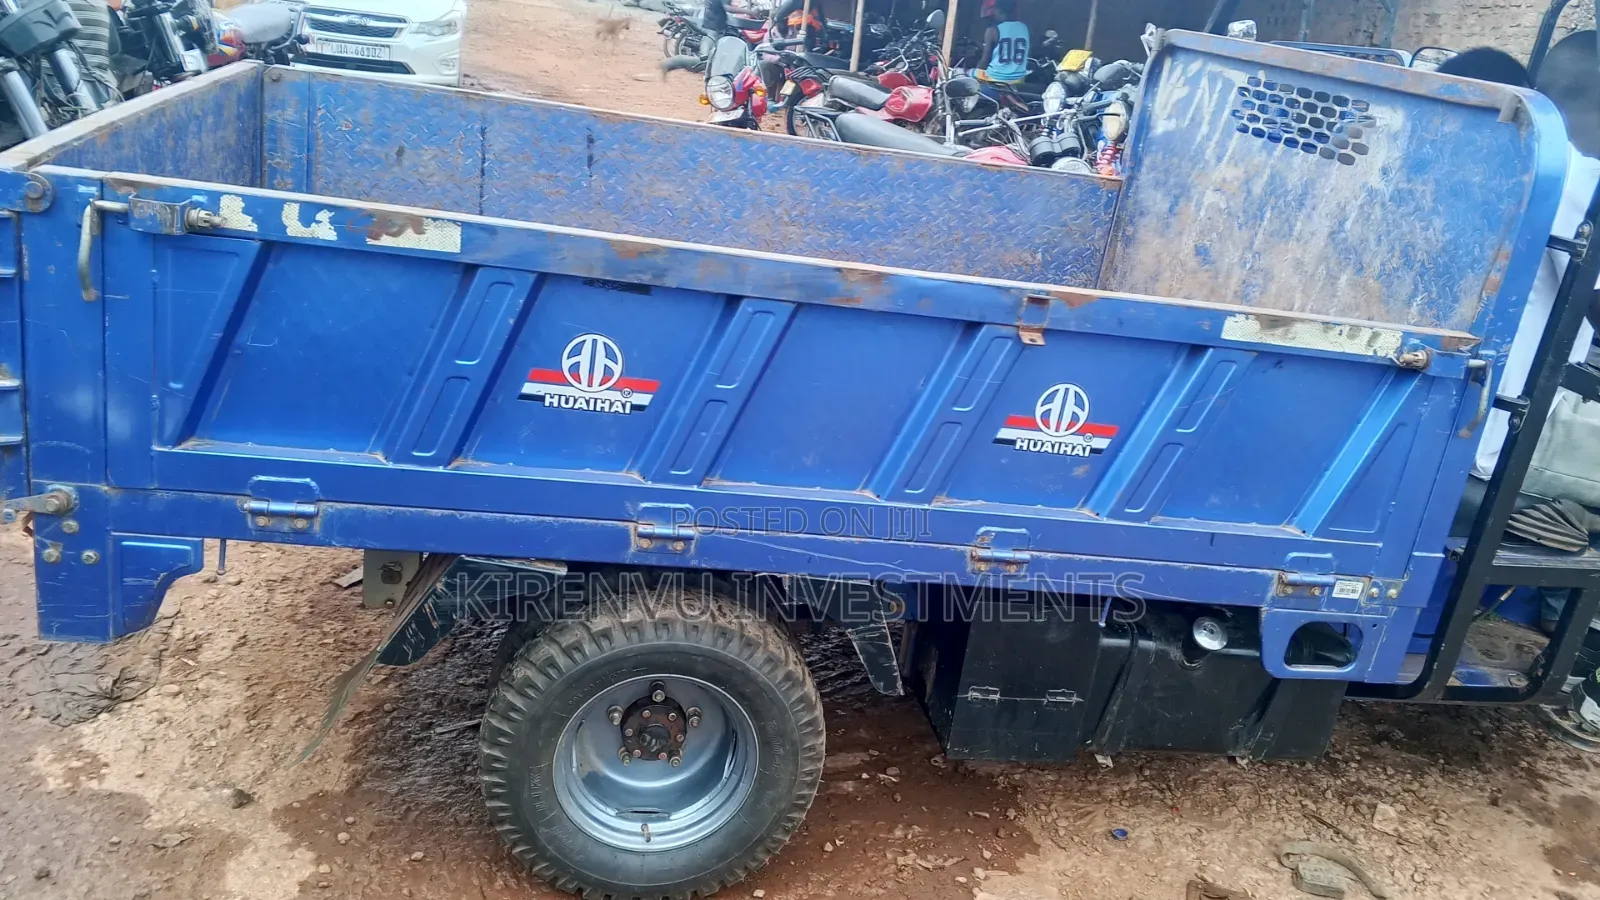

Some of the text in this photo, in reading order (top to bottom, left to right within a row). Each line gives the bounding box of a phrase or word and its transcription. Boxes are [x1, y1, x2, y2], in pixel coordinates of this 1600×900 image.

[999, 37, 1027, 65] 06
[544, 392, 632, 415] HUAIHAI
[1015, 437, 1091, 458] HUAIHAI
